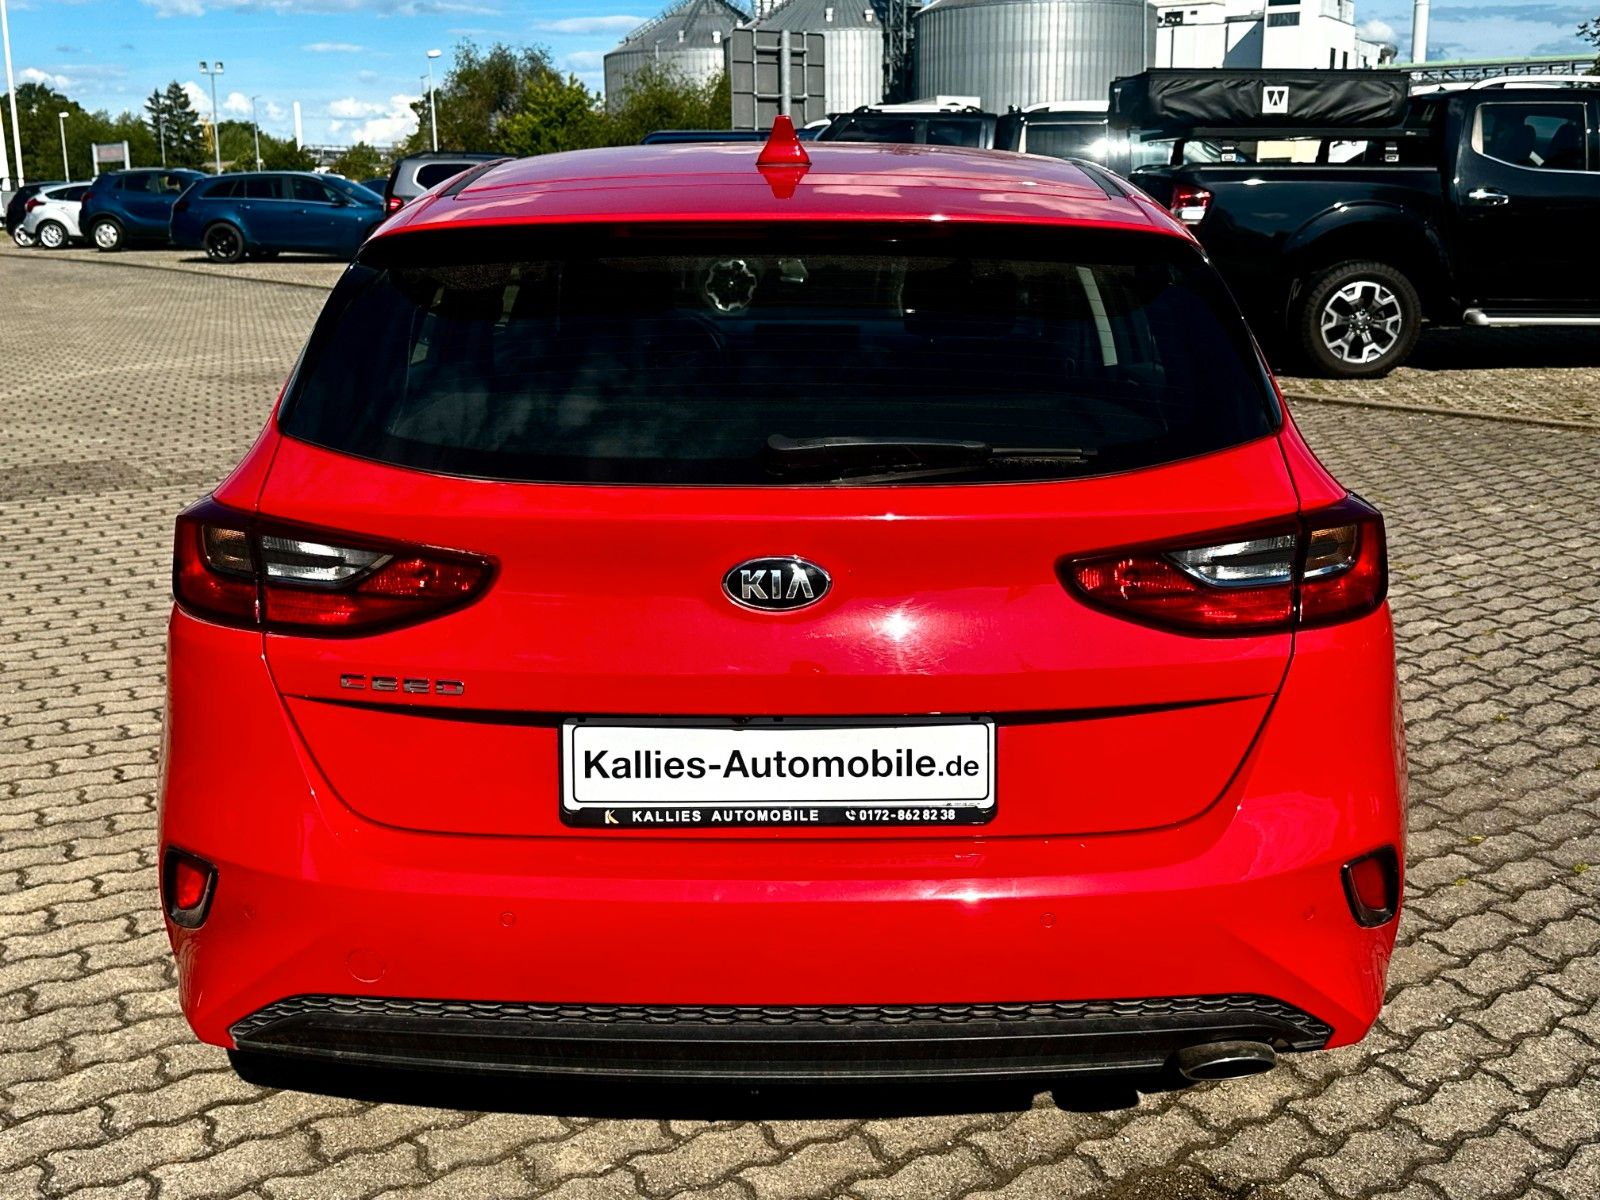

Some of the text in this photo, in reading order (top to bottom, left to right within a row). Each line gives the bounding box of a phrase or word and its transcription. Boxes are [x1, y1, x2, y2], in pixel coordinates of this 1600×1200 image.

[740, 563, 814, 599] KIA
[341, 674, 464, 695] CEED
[583, 748, 980, 779] Kallies-Automobile.de
[632, 810, 702, 823] KALLIES
[711, 809, 819, 822] AUTOMOBILE
